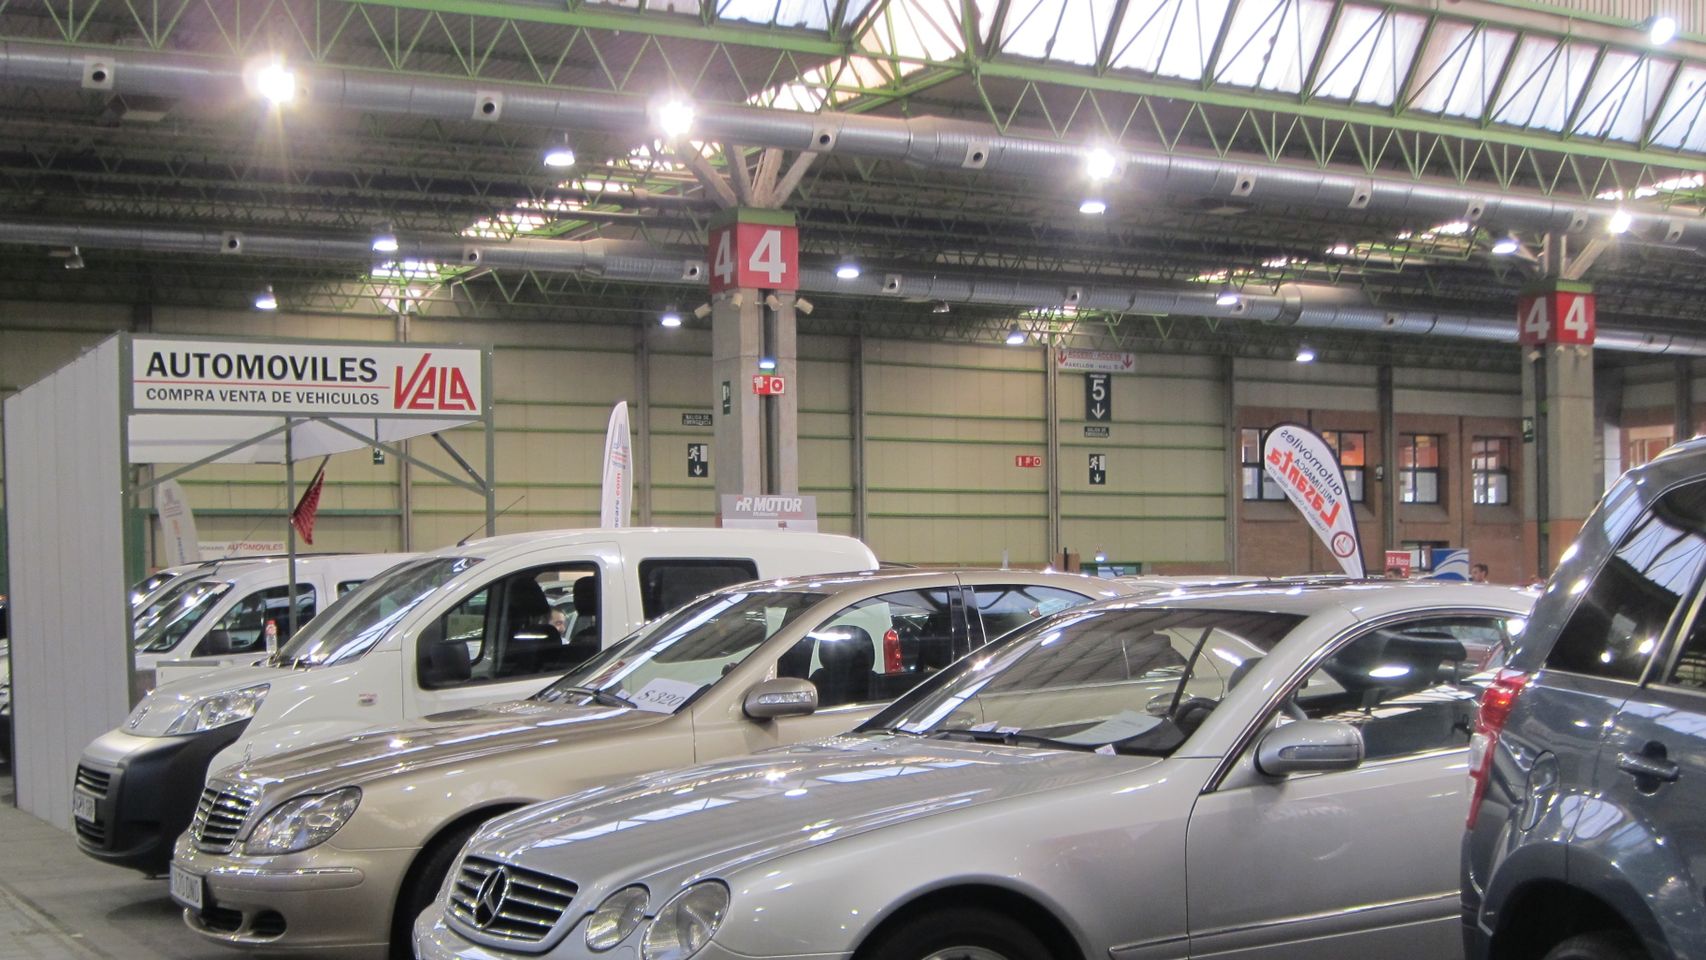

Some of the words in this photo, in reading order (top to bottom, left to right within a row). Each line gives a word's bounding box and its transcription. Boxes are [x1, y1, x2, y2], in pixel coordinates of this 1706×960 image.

[714, 231, 733, 284] 4
[749, 230, 786, 283] 4
[1525, 296, 1550, 340] 4
[1564, 296, 1588, 339] 4
[146, 351, 378, 383] AUTOMOVILES
[146, 387, 215, 402] COMPRA
[219, 389, 267, 403] VENTA
[272, 391, 292, 404] DE
[296, 391, 379, 405] VEHICULOS
[1092, 379, 1105, 401] 5
[753, 497, 802, 513] MOTOR
[227, 542, 284, 552] AUTOMOVILES
